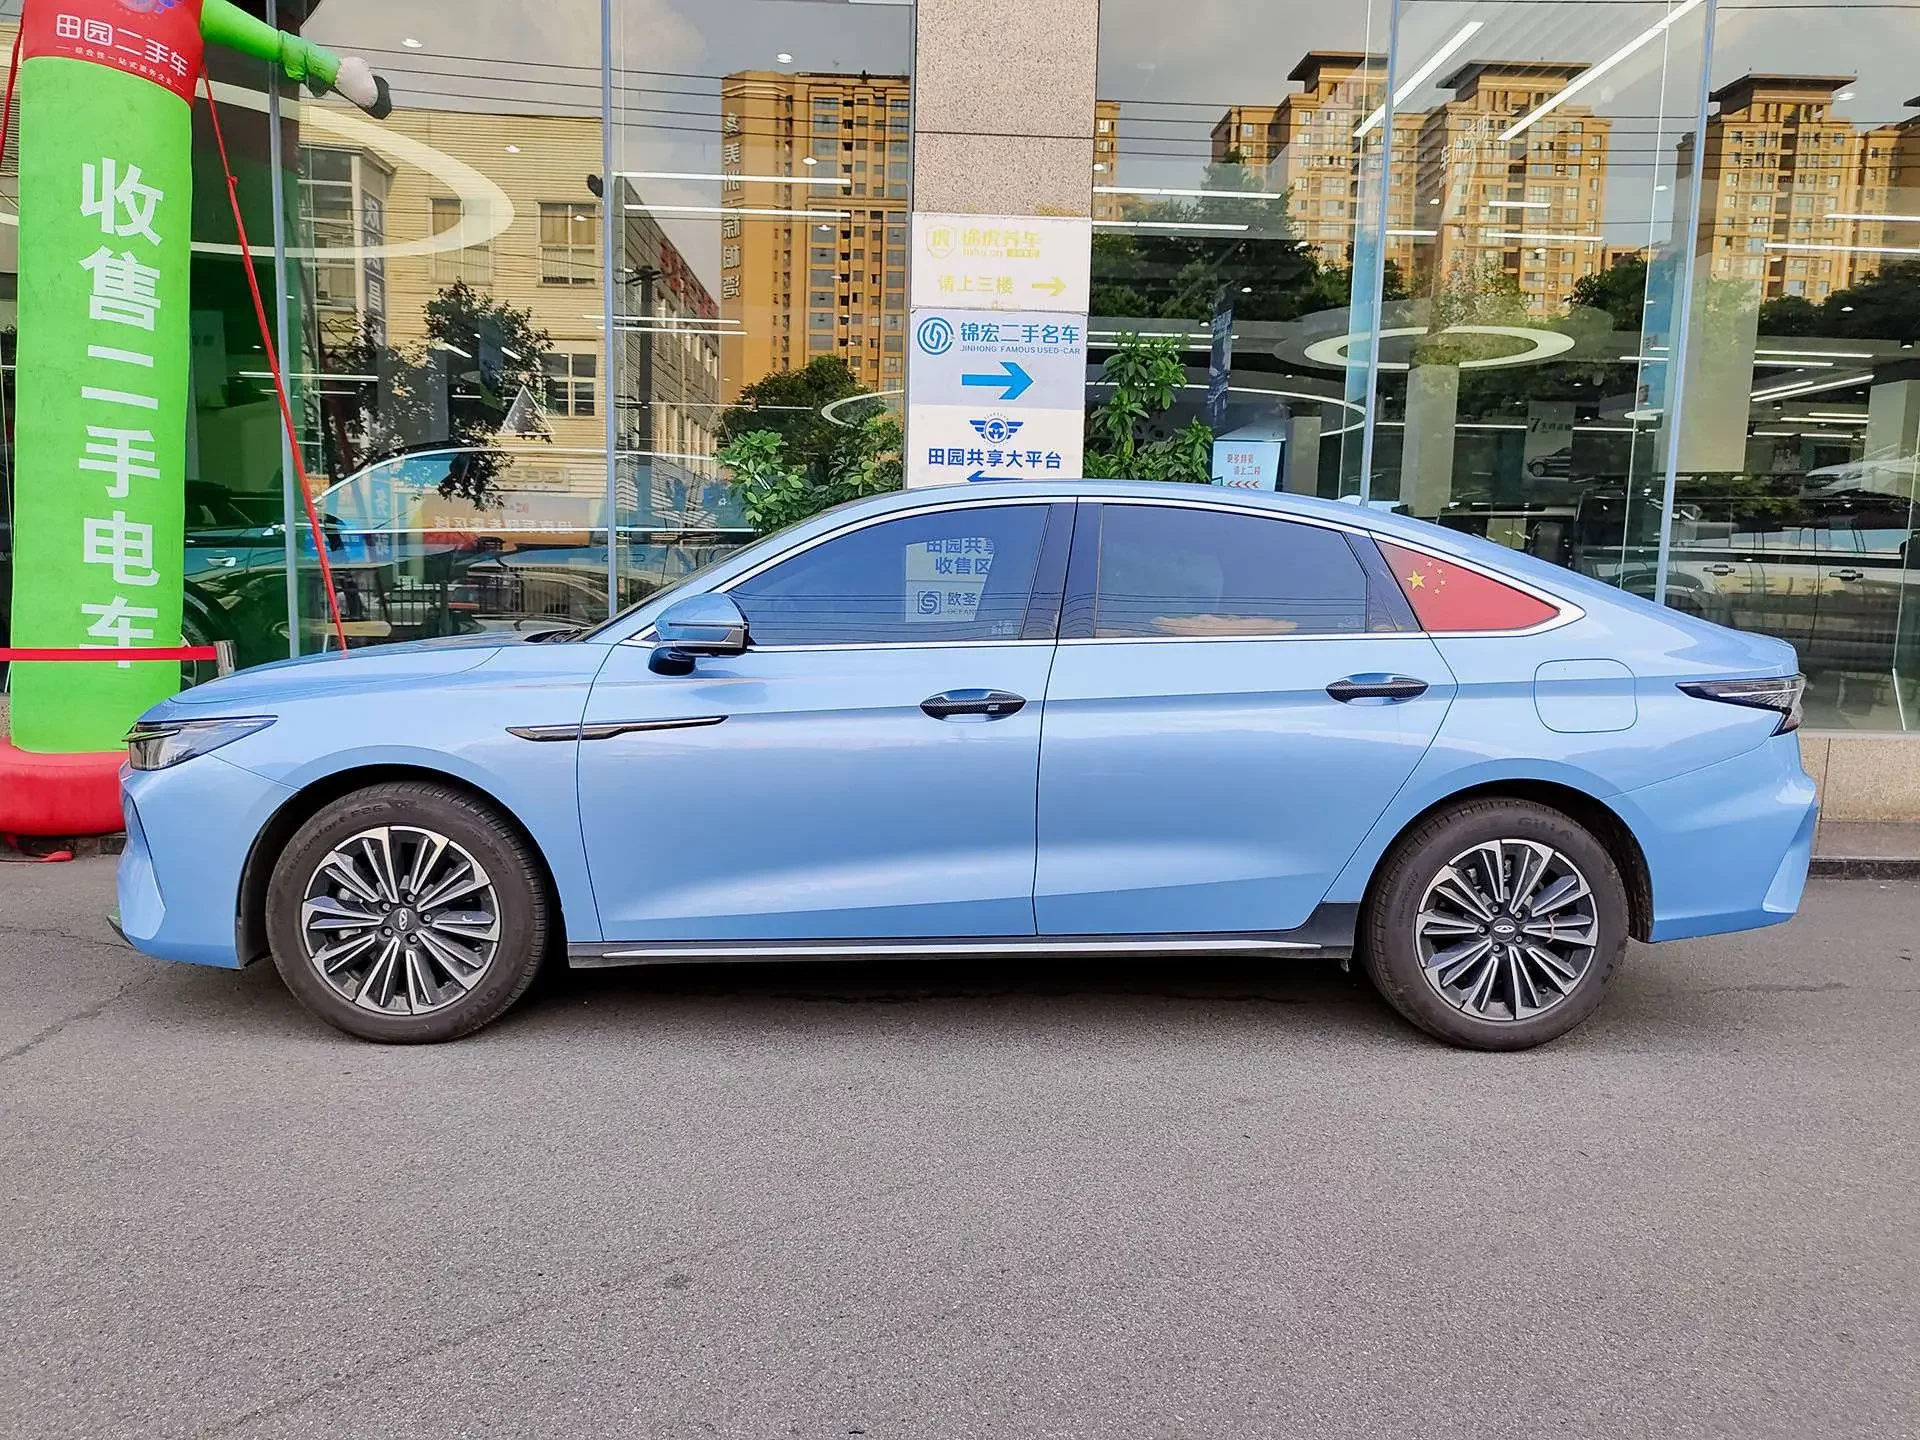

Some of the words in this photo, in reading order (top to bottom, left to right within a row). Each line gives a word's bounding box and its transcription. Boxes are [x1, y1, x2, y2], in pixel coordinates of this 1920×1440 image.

[56, 13, 189, 77] 田园二手车
[938, 275, 1013, 295] 请上三楼
[960, 322, 1080, 345] 锦宏二手名车
[960, 345, 997, 353] JINHONG
[1000, 346, 1035, 354] FAMOUS
[1038, 347, 1081, 355] USED-CAR
[79, 157, 164, 669] 收售二手电车
[928, 447, 1062, 470] 田园共享大平台
[935, 556, 991, 575] 收售区
[947, 591, 977, 606] 欧圣
